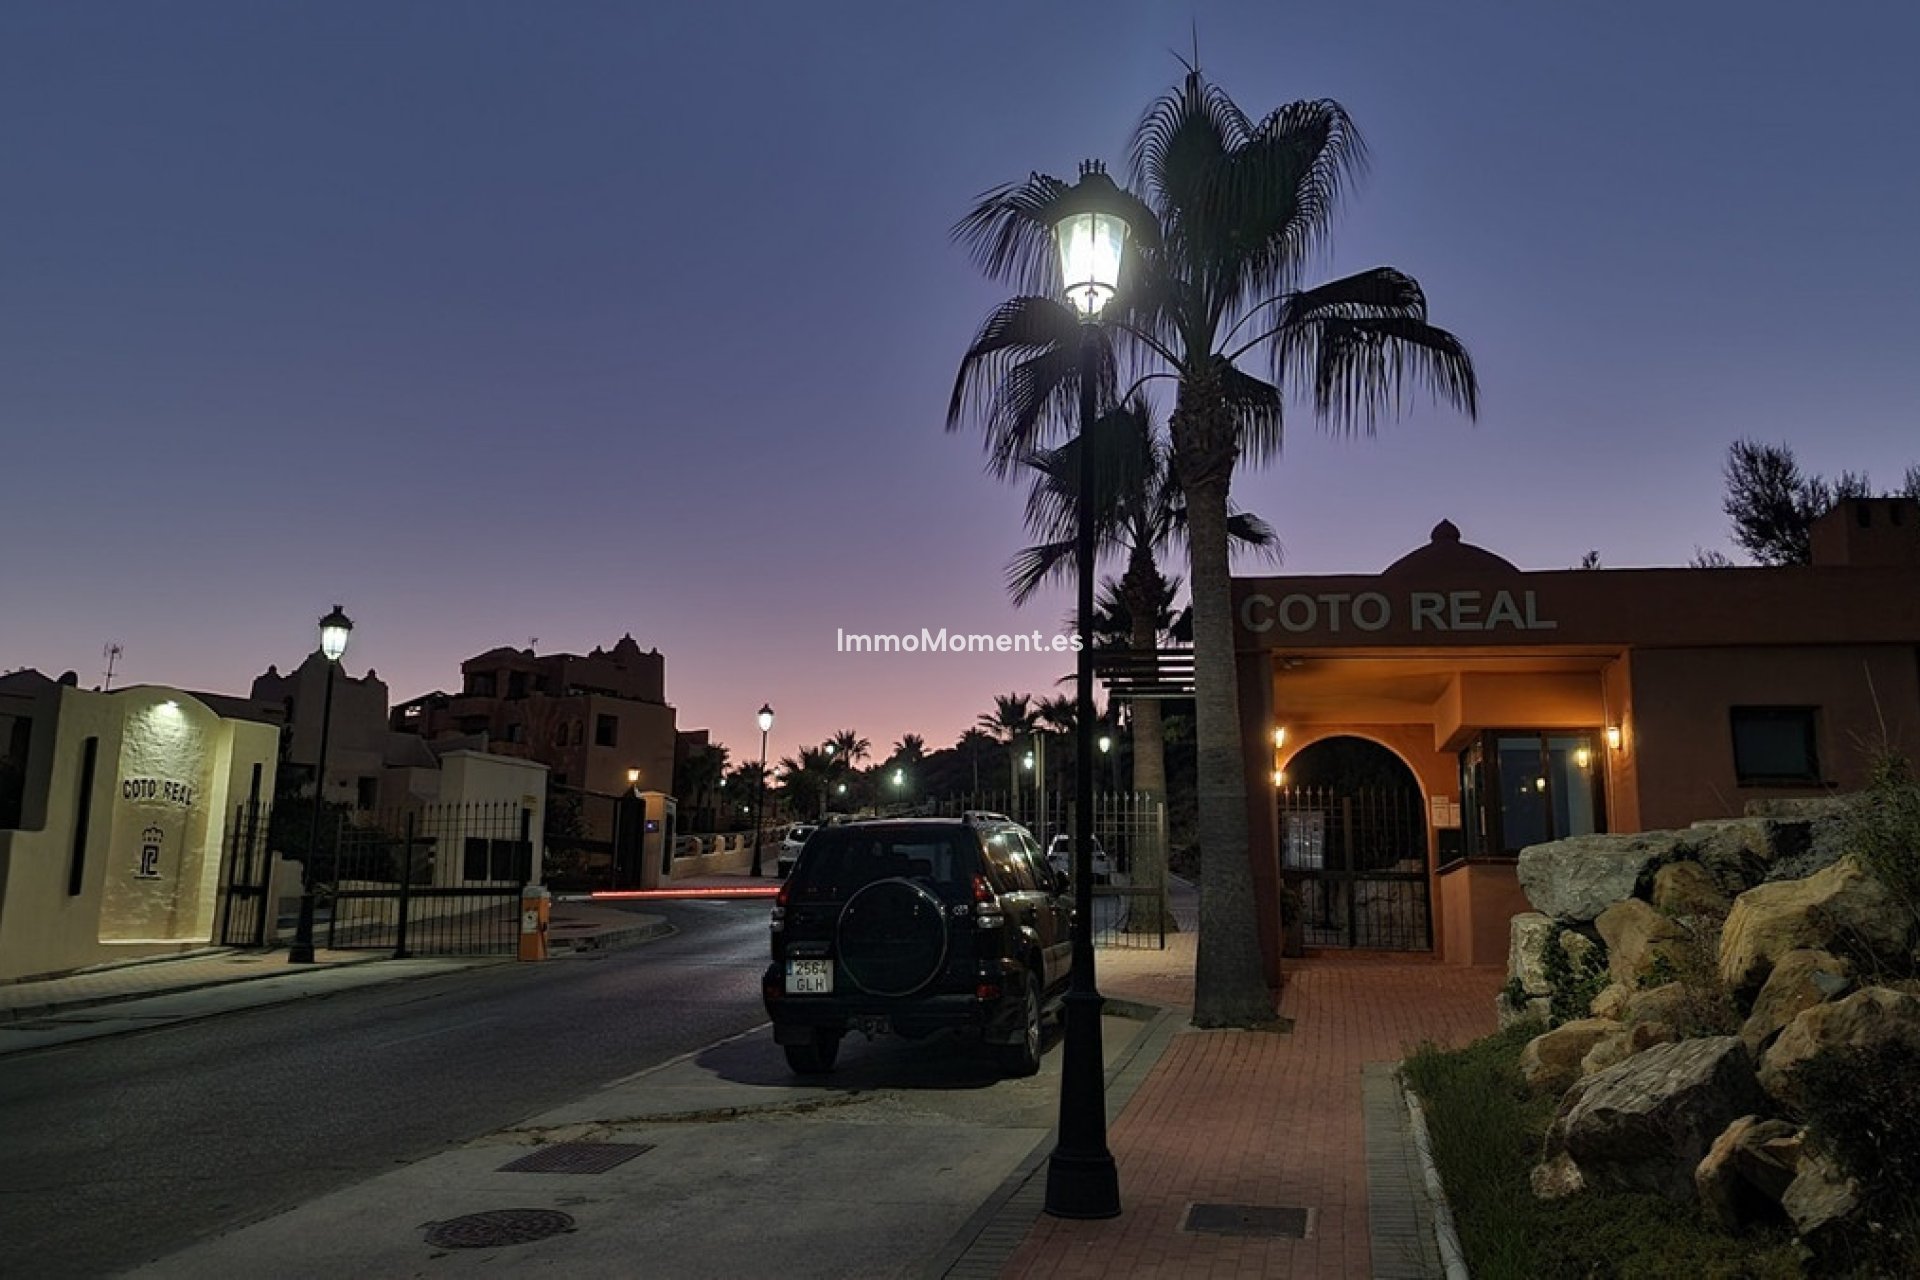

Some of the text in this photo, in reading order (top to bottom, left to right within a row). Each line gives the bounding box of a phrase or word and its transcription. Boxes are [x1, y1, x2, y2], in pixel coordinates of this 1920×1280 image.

[1241, 590, 1557, 633] COTO REAL
[123, 779, 192, 805] COTO REAL
[797, 978, 824, 991] GLH
